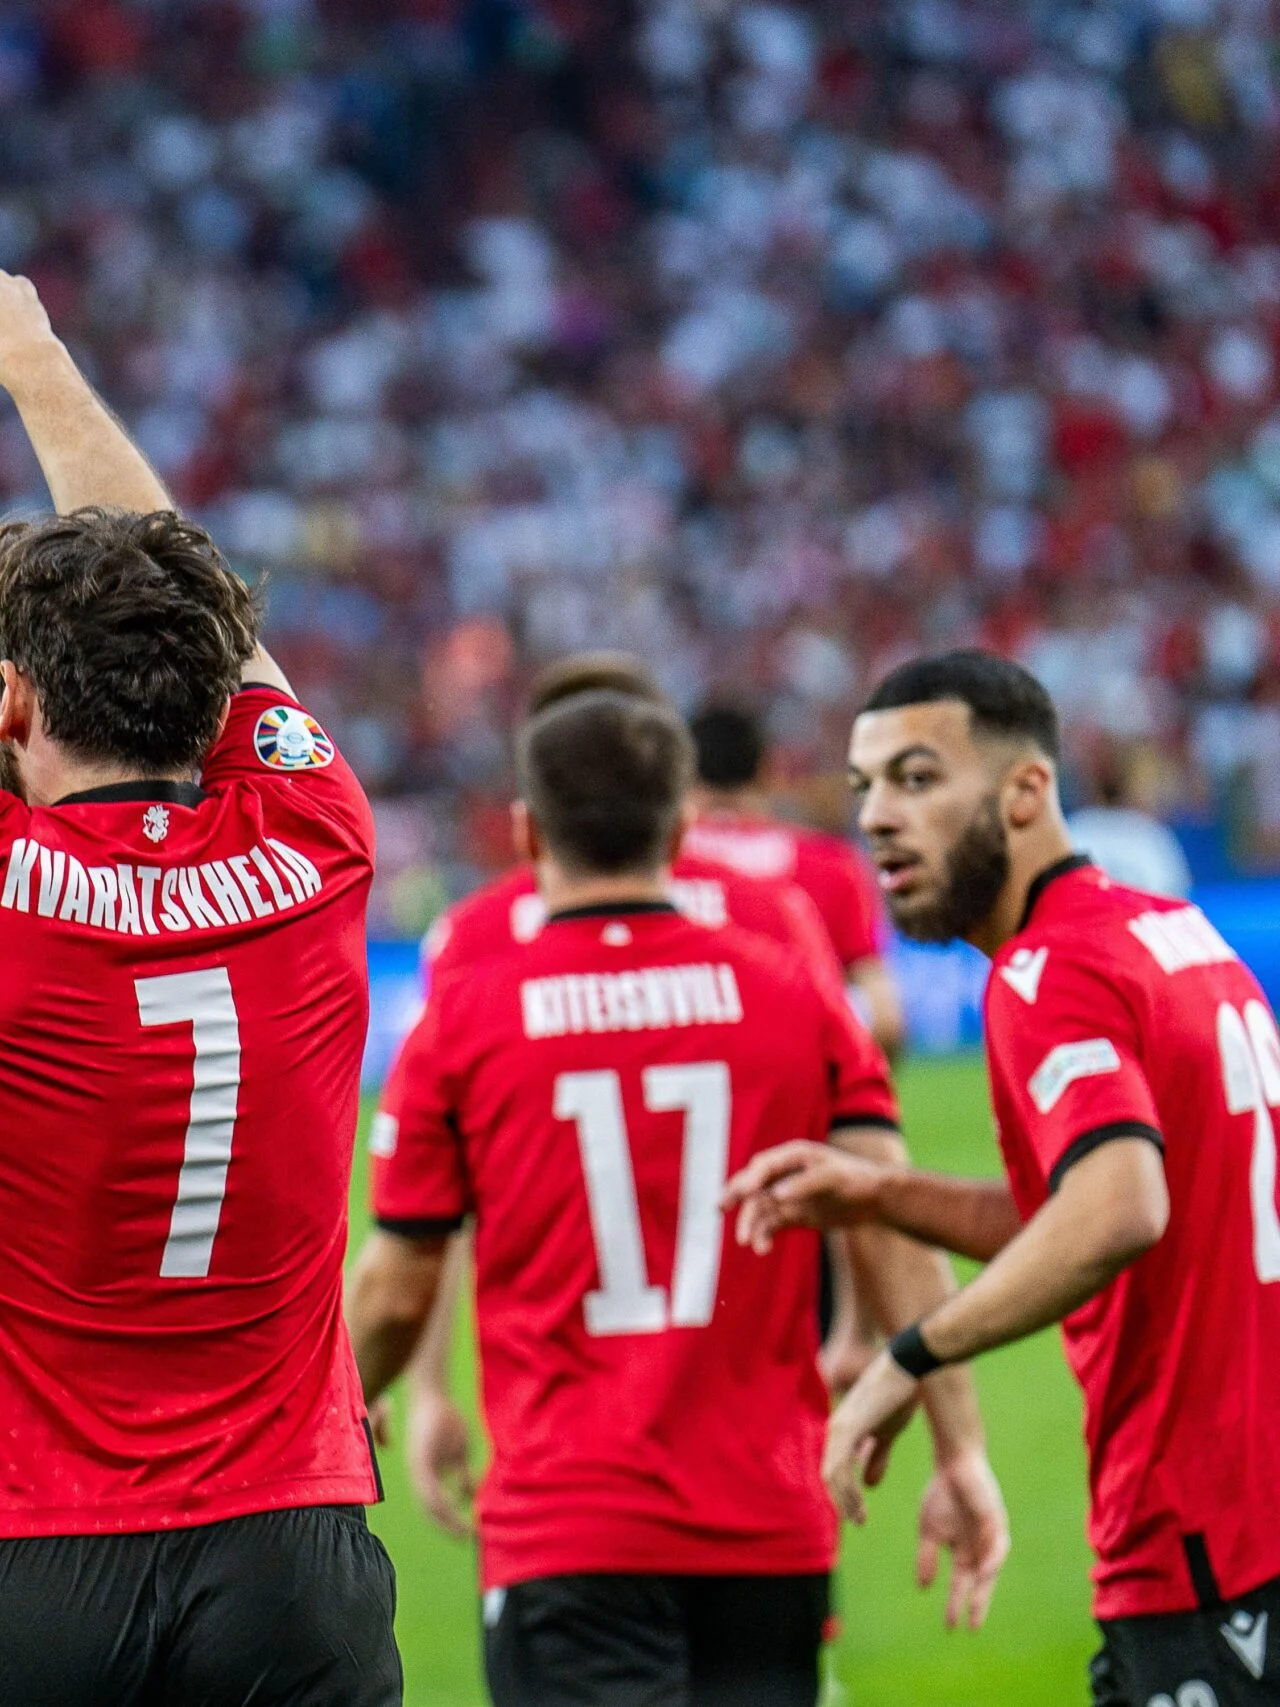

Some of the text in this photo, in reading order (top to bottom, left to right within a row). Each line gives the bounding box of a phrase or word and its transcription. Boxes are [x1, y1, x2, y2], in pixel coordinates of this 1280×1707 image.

[1, 838, 322, 936] KVARATSKHELIA
[134, 967, 240, 1277] 7
[553, 1061, 732, 1336] 17
